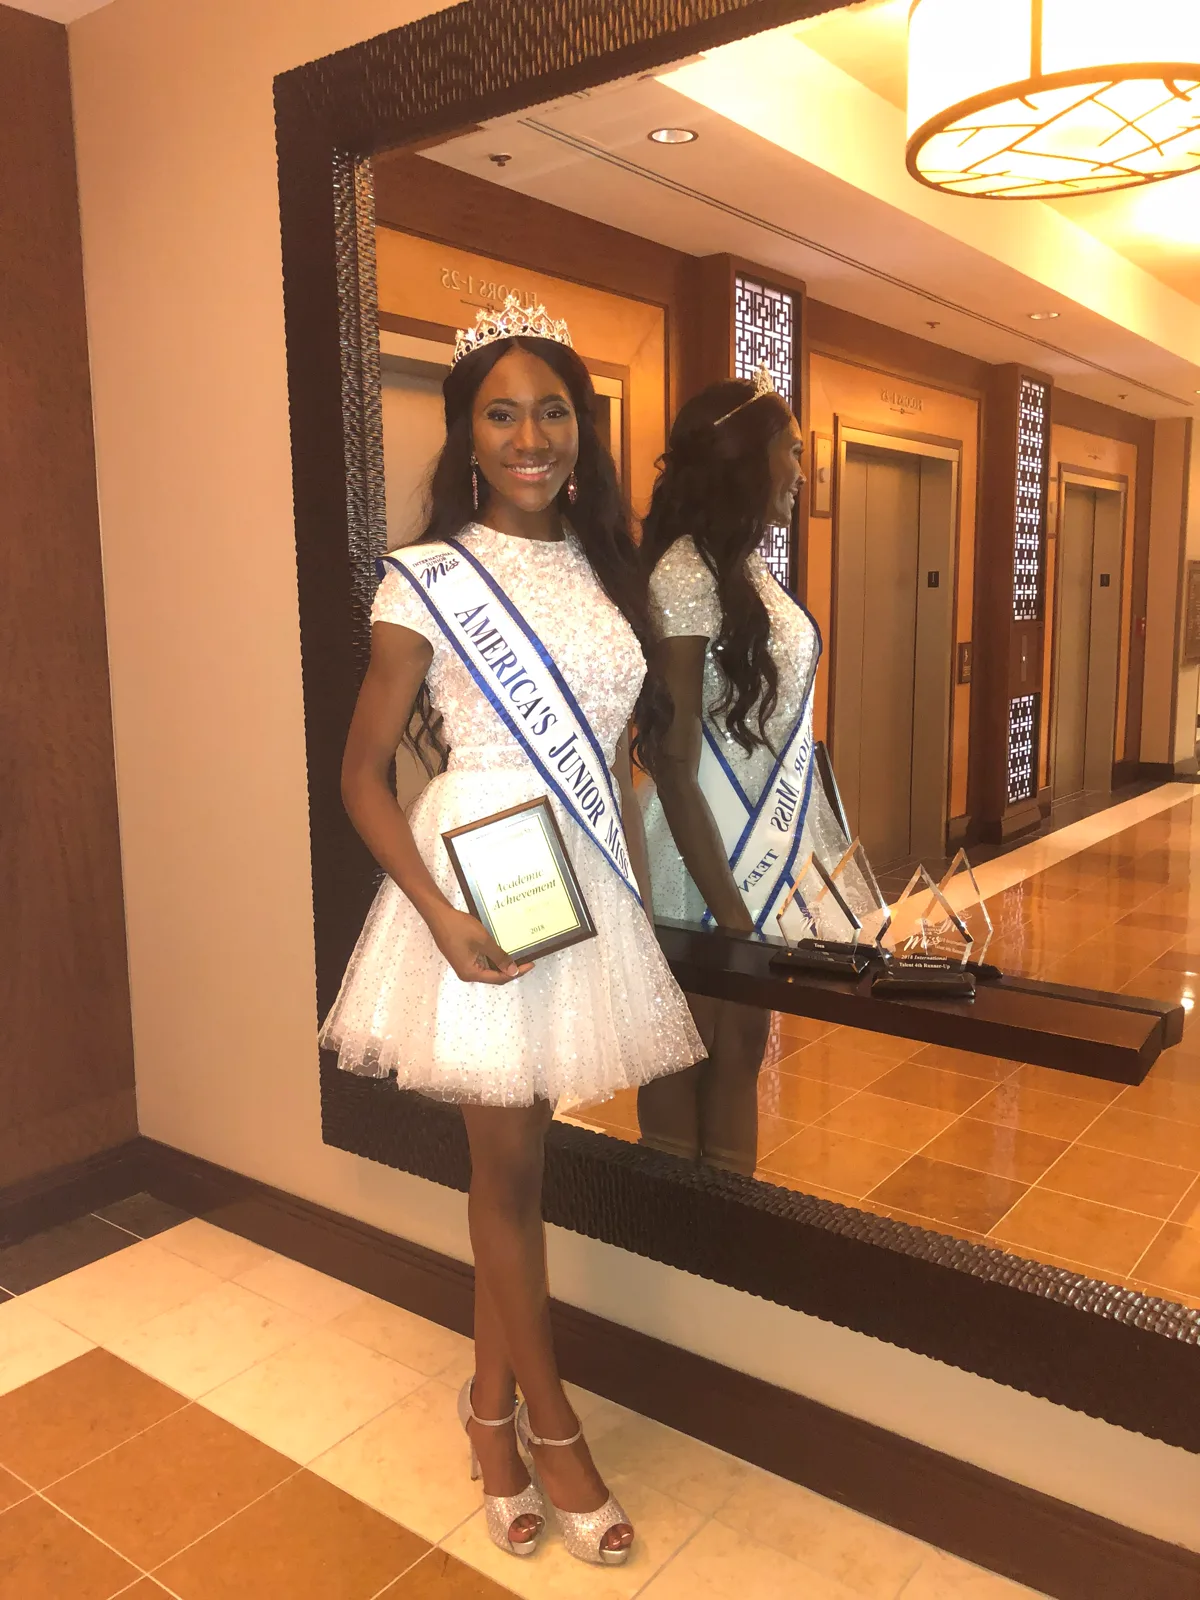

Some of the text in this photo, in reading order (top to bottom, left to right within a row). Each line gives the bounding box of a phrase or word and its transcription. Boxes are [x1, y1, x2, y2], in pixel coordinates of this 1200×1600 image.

[420, 558, 460, 589] Miss
[454, 602, 629, 879] AMERICA'S JUNIOR MISS
[493, 879, 557, 911] Achievement
[495, 869, 544, 893] Academic
[530, 924, 546, 935] 2018
